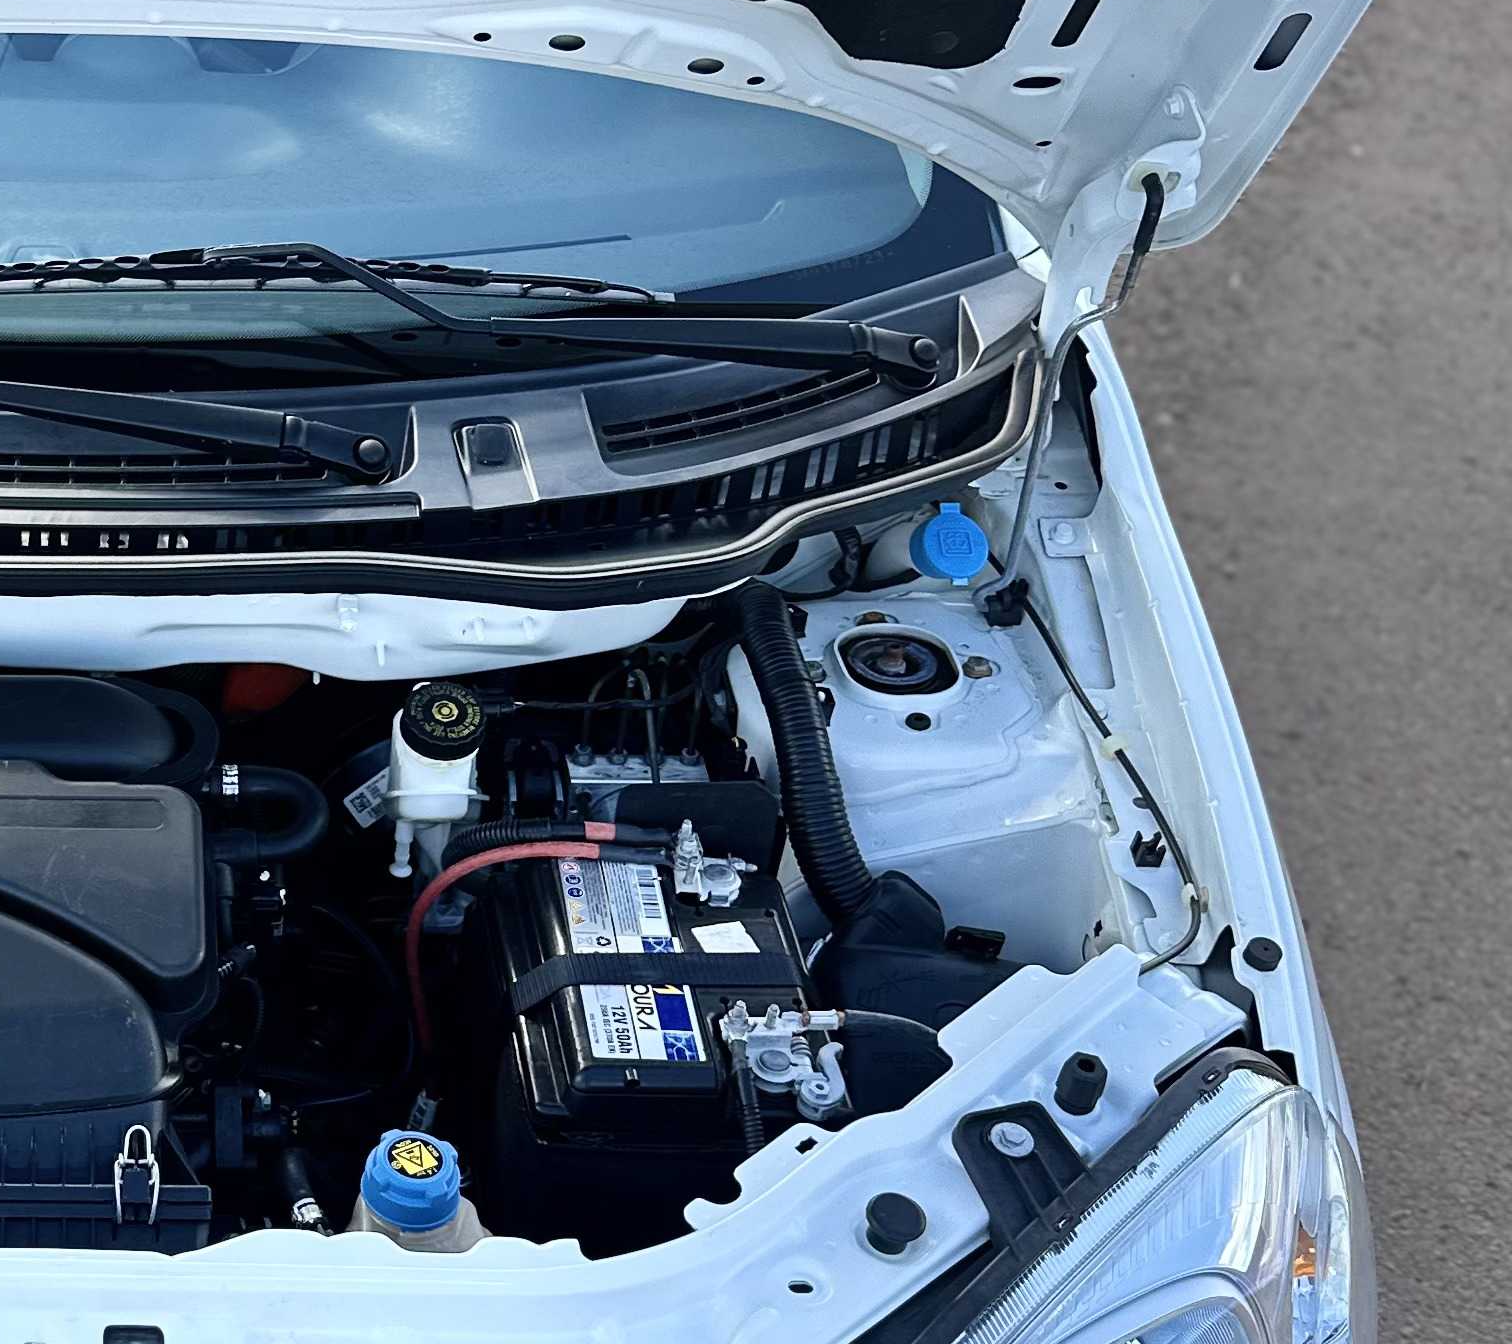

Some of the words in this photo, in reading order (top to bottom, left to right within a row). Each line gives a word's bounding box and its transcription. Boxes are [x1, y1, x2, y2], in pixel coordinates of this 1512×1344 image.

[611, 1005, 628, 1024] 12V
[630, 984, 658, 1030] OURA
[615, 1027, 633, 1053] 50Ah
